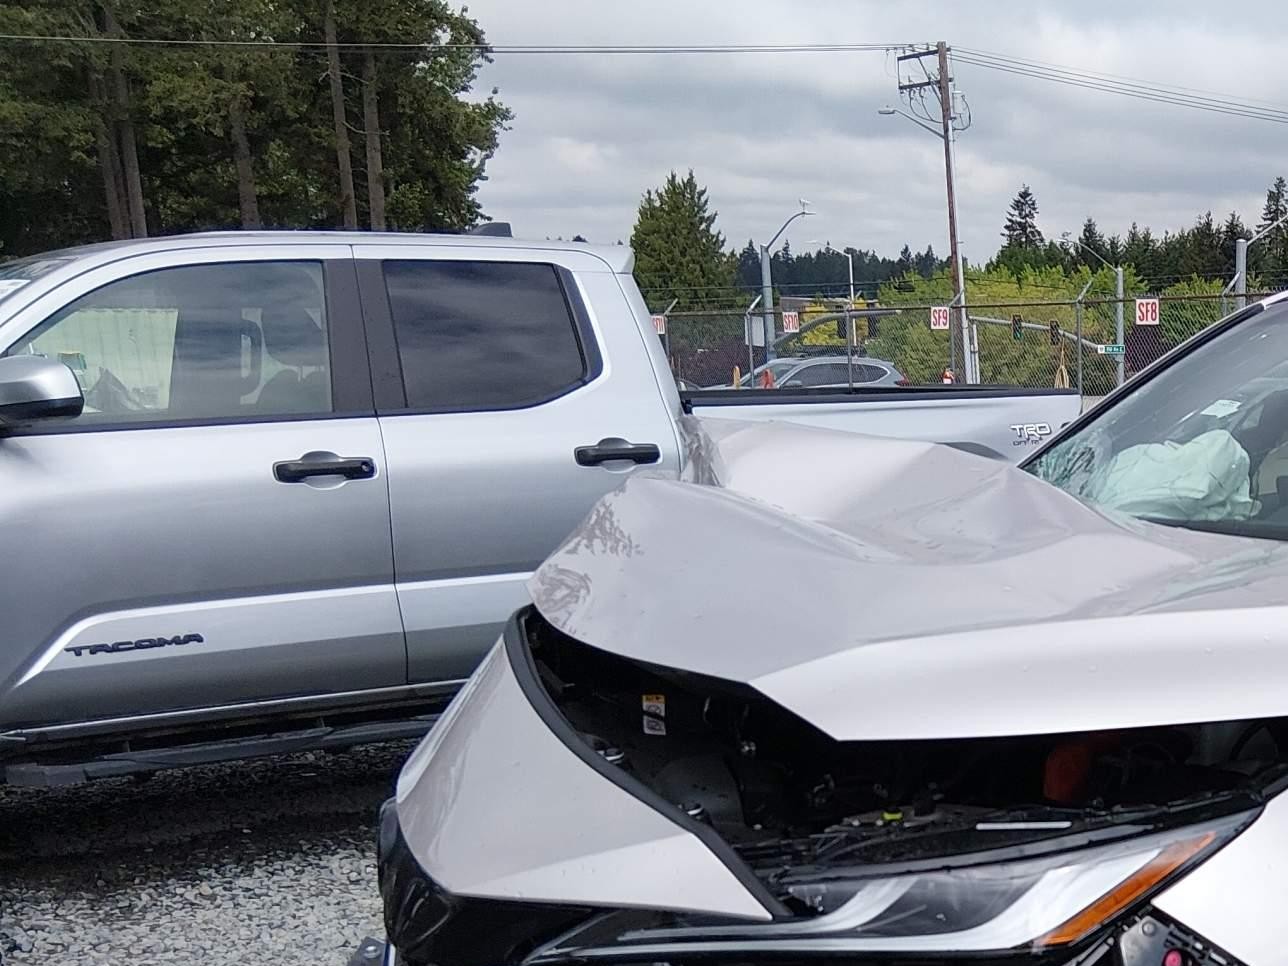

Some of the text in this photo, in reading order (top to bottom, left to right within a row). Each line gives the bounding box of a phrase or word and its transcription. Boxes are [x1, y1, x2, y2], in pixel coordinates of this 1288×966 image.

[932, 308, 948, 327] SF9
[1137, 301, 1158, 322] SF8
[784, 314, 798, 330] SF10
[1010, 422, 1052, 440] TRD
[64, 633, 204, 656] TACOMA
